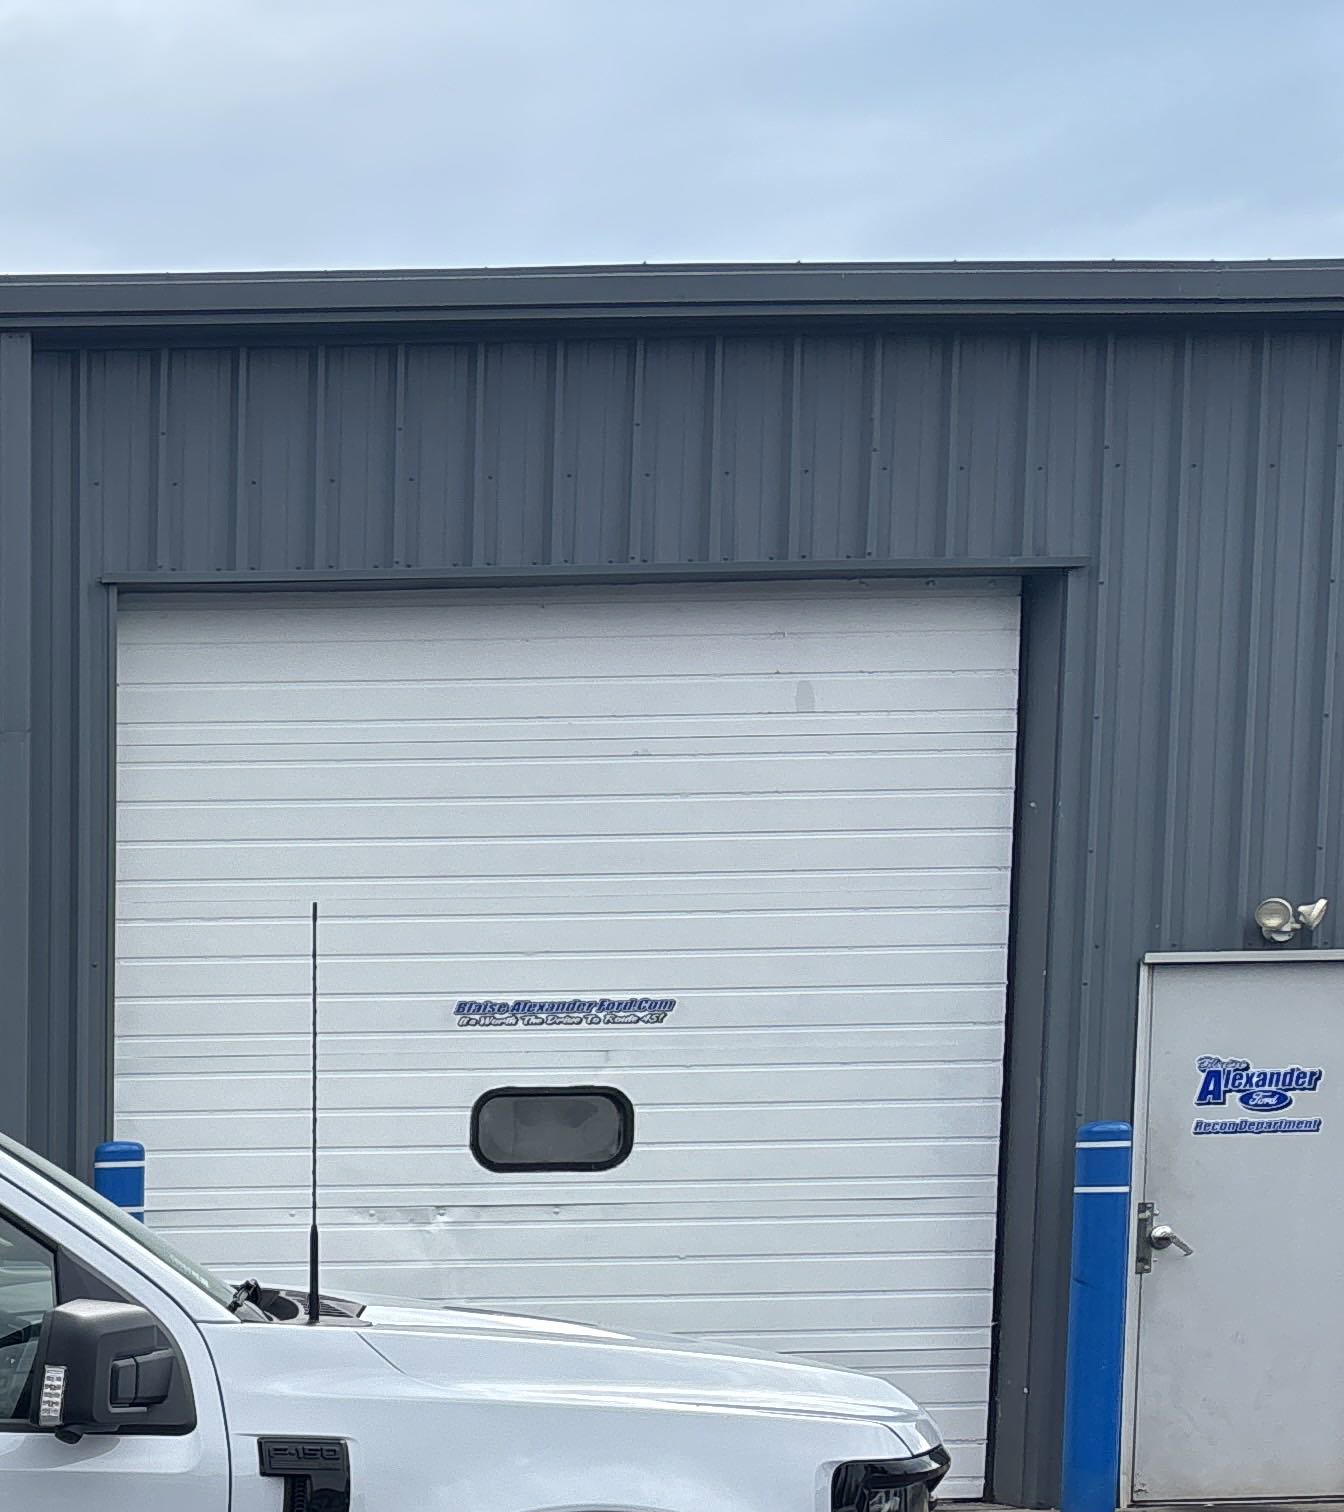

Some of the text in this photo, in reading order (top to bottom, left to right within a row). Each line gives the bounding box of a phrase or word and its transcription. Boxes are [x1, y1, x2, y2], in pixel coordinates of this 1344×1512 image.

[454, 1000, 509, 1015] Blaise
[510, 999, 597, 1014] Alexander
[479, 1014, 519, 1027] Worth
[521, 1014, 545, 1026] The
[546, 1014, 583, 1025] Drive
[583, 1013, 601, 1025] To
[602, 1012, 640, 1025] Route
[1195, 1066, 1322, 1106] Alexander
[1248, 1092, 1280, 1105] Ford
[267, 1445, 342, 1461] F-150
